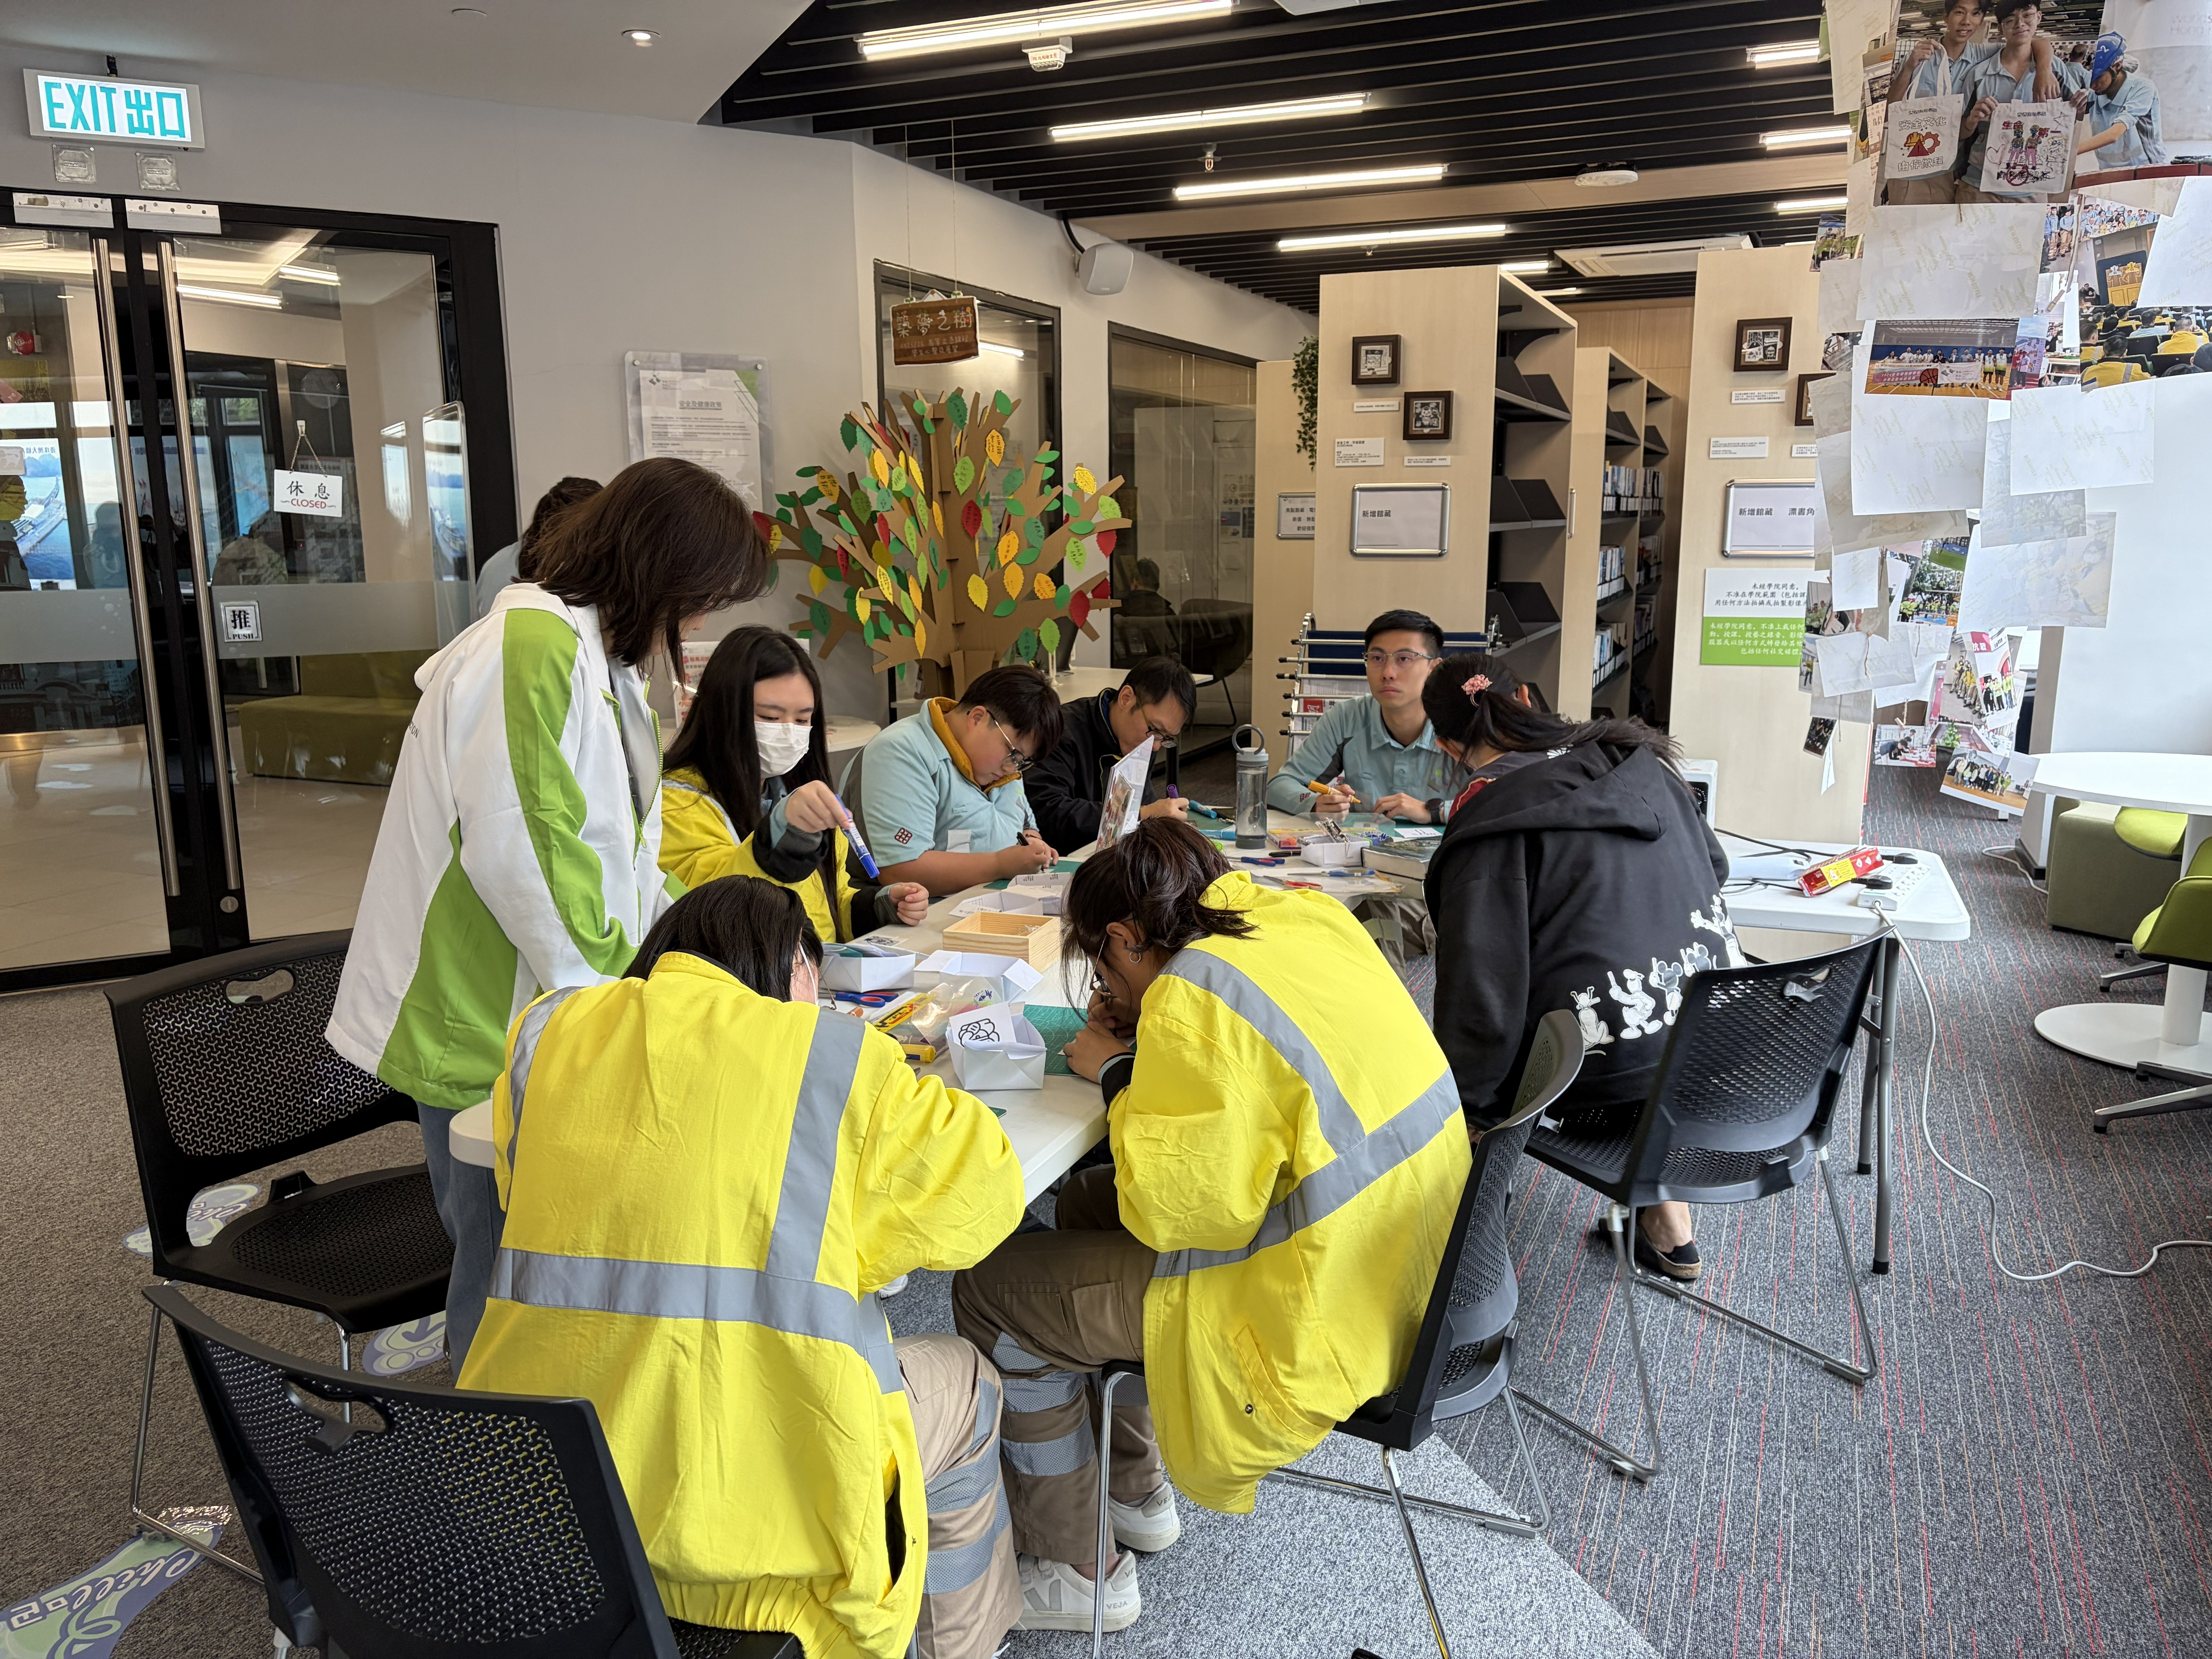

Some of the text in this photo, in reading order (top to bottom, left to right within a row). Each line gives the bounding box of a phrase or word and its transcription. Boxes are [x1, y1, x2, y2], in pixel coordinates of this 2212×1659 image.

[44, 81, 186, 138] EXIT 出口
[1899, 116, 1946, 131] 安全文化
[896, 309, 973, 338] 築夢之樹
[287, 481, 330, 500] 休息
[291, 498, 326, 509] CLOSED
[1739, 507, 1815, 516] 新增館藏 漂書角
[230, 610, 251, 630] 推
[1106, 1601, 1128, 1610] VEJA
